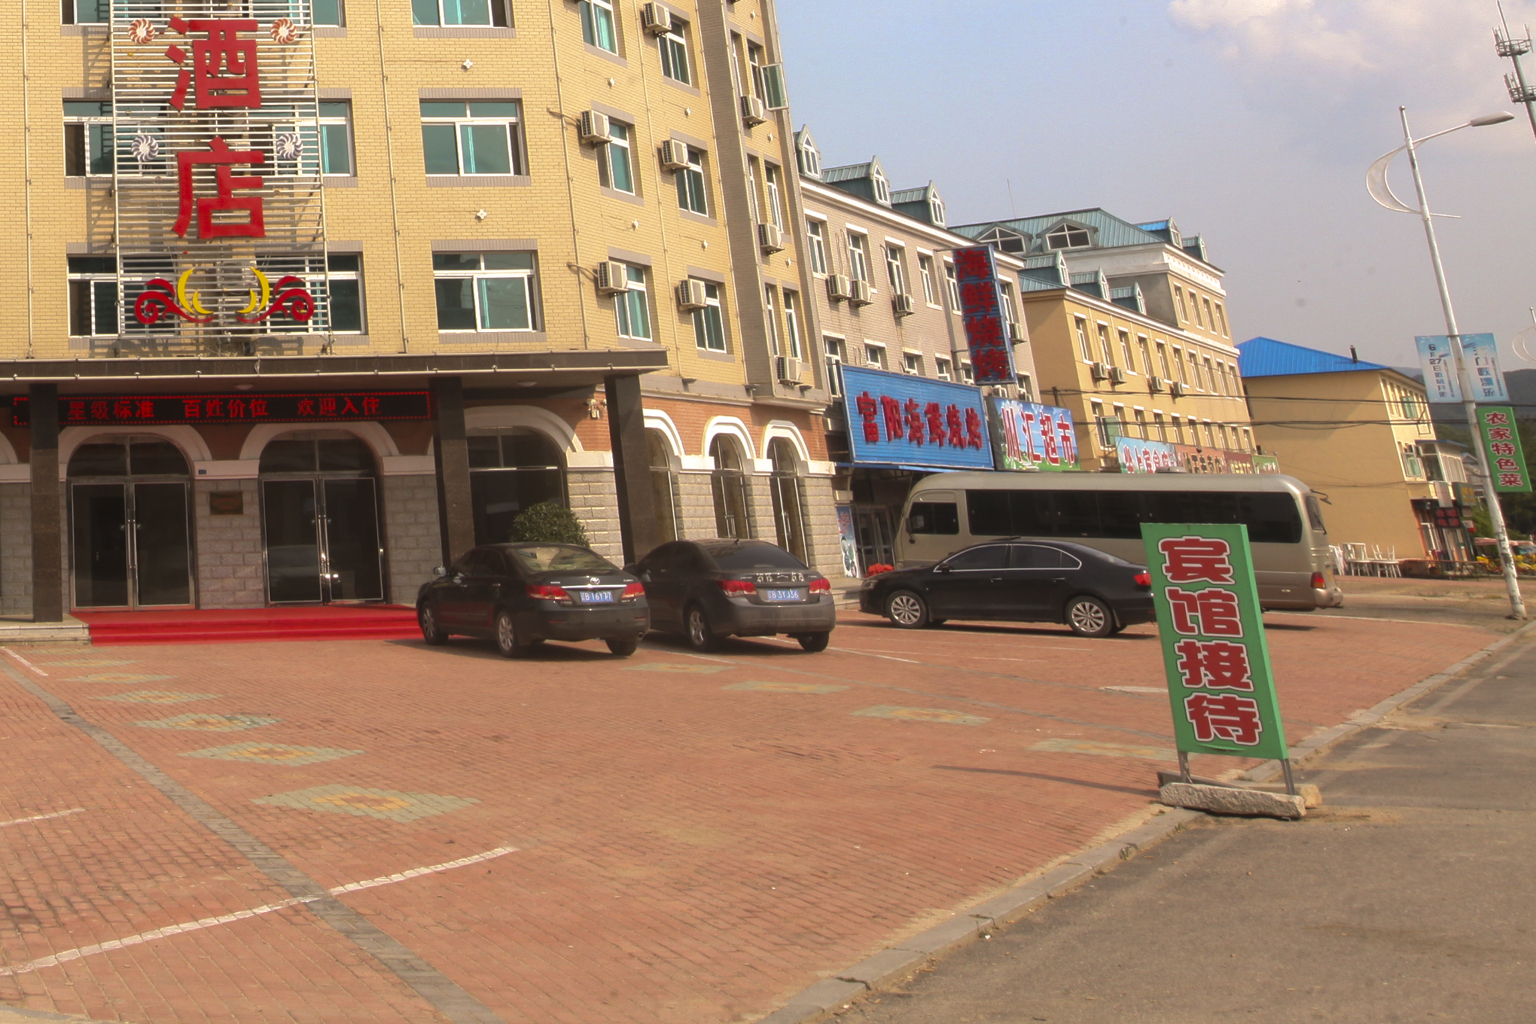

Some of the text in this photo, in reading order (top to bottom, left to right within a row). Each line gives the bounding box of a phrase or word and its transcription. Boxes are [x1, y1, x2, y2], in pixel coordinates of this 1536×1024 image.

[953, 248, 1010, 381] 海鲜烧烤
[67, 396, 382, 421] 星级标准 百姓价位 欢迎入住
[856, 392, 983, 450] 富阳海鲜烧烤
[1001, 406, 1076, 467] 川汇超市
[1485, 412, 1524, 487] 农家特色菜
[1158, 535, 1263, 746] 宾馆接待
